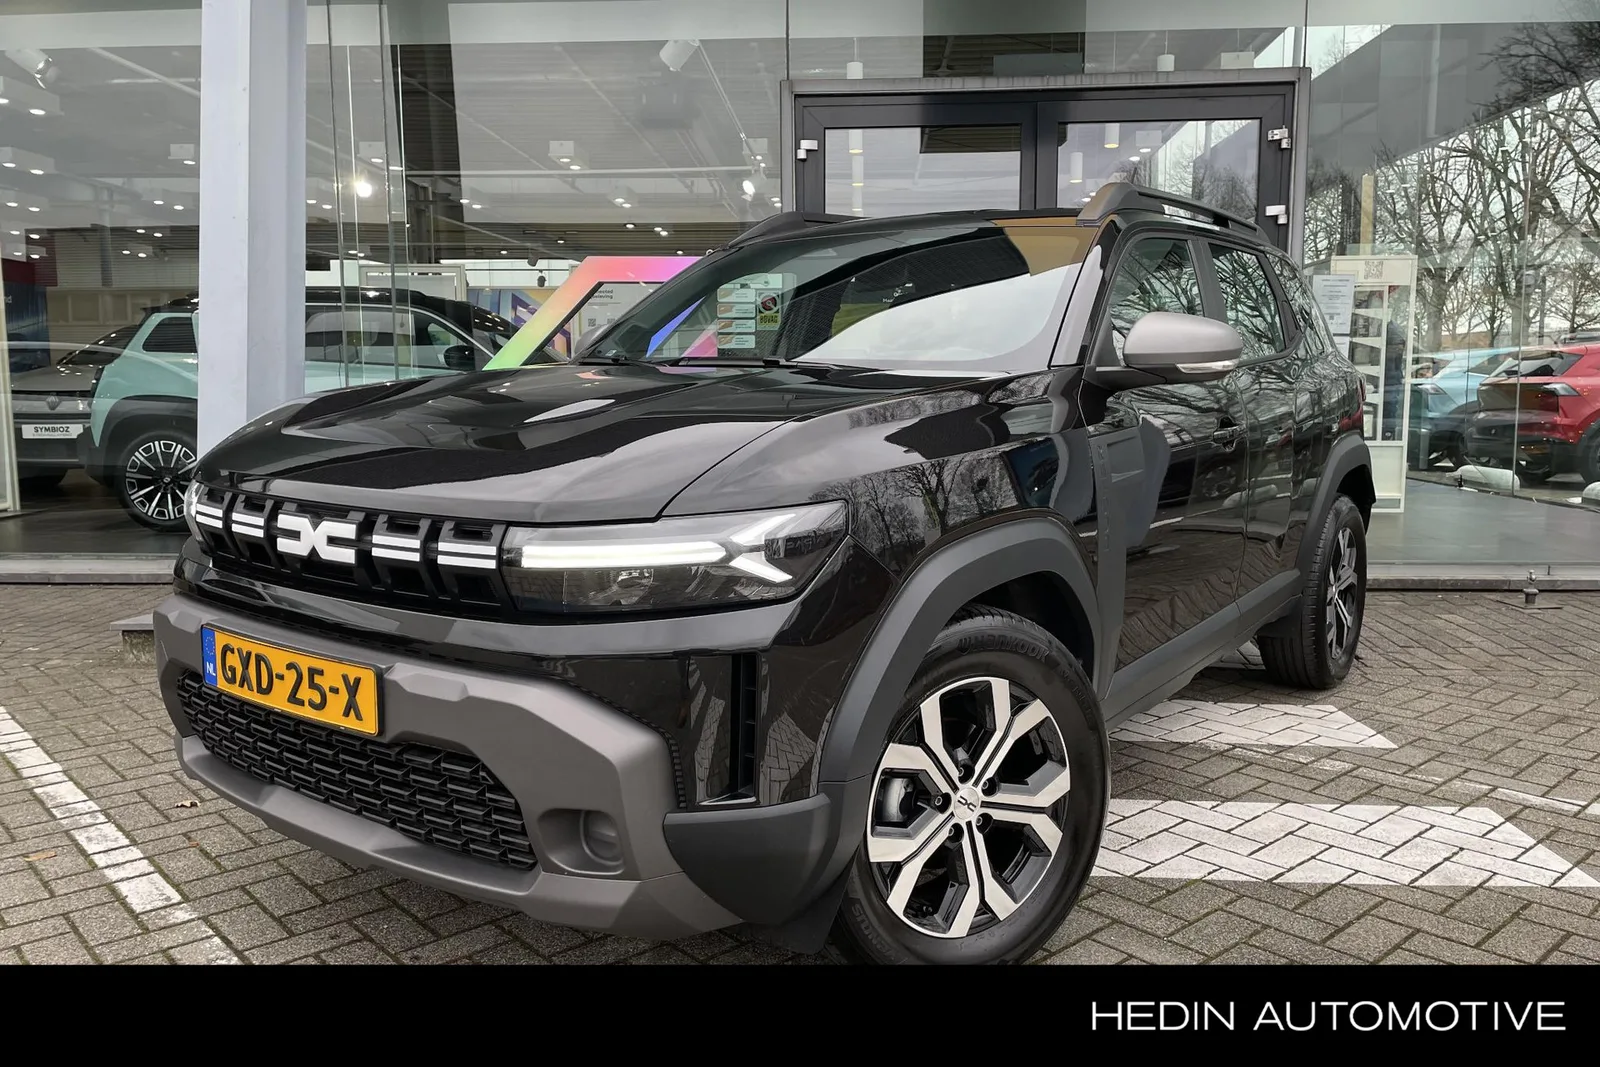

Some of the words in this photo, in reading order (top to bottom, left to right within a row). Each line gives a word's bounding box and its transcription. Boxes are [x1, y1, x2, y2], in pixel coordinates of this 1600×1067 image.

[760, 315, 778, 324] BOVAG
[206, 661, 216, 677] NL
[220, 643, 364, 722] GXD-25-X
